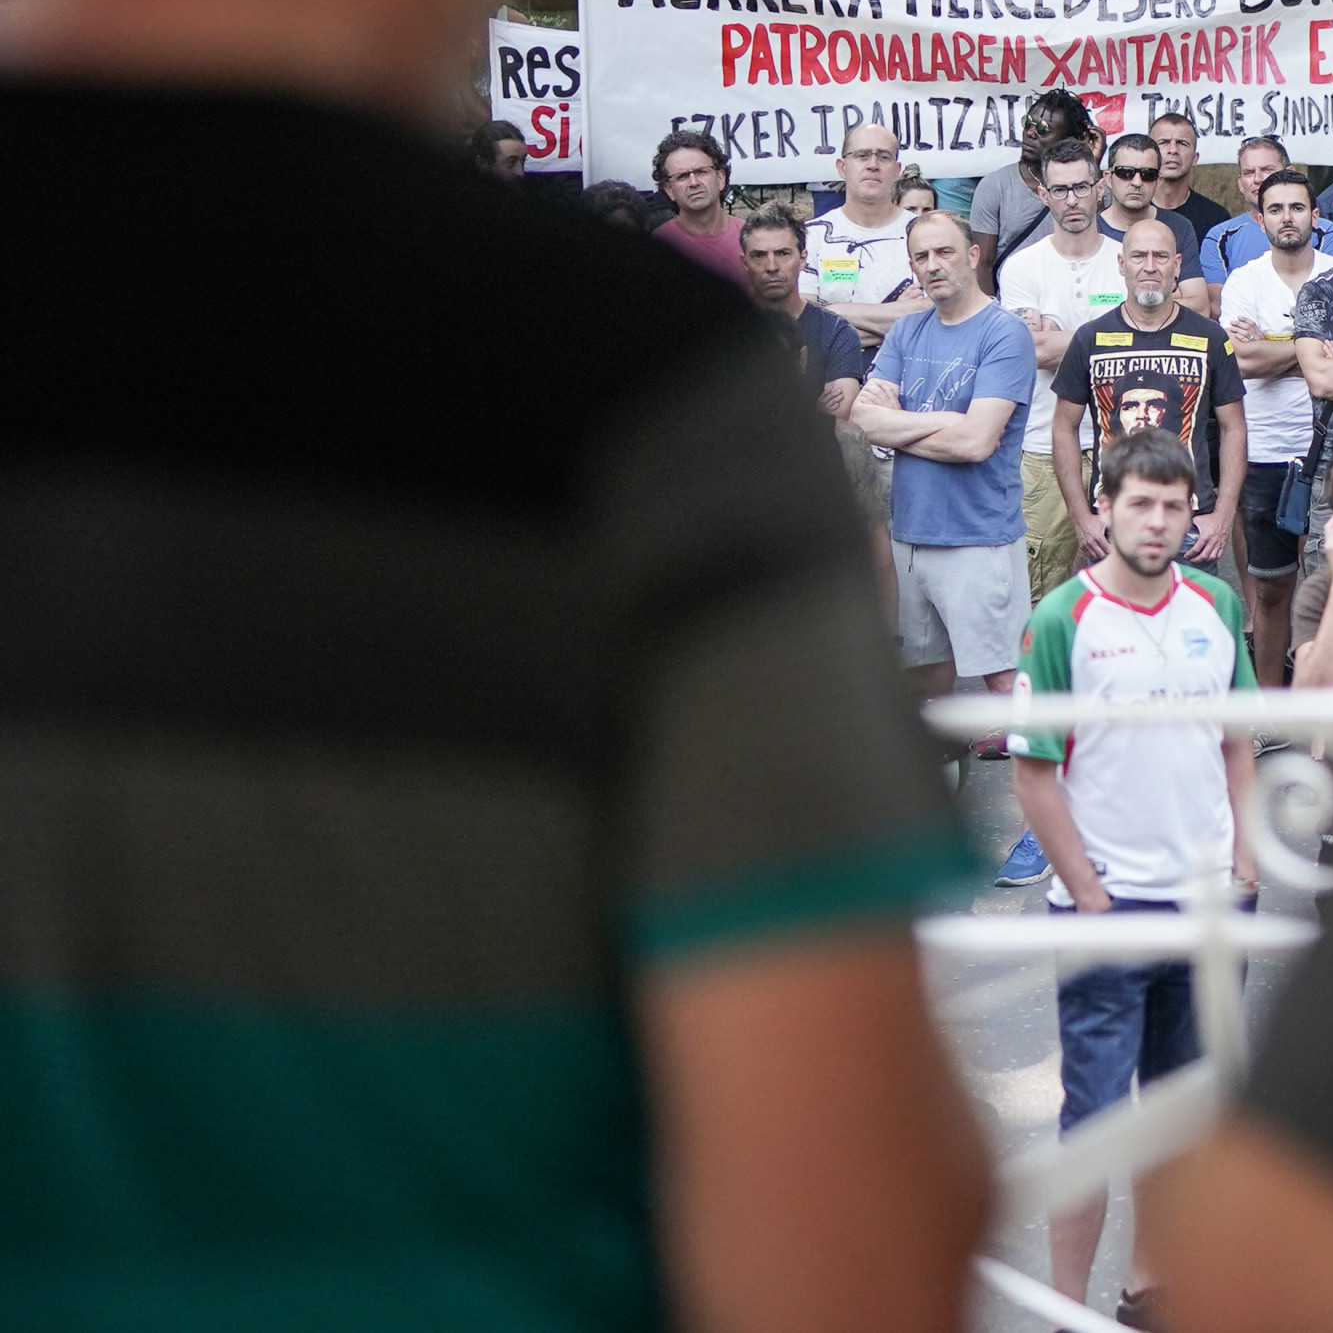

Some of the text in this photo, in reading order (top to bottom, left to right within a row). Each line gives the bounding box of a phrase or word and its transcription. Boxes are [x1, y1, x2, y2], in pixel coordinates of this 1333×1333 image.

[722, 22, 1027, 87] PATRONALAREN
[1094, 356, 1201, 379] CHE GUEVARA
